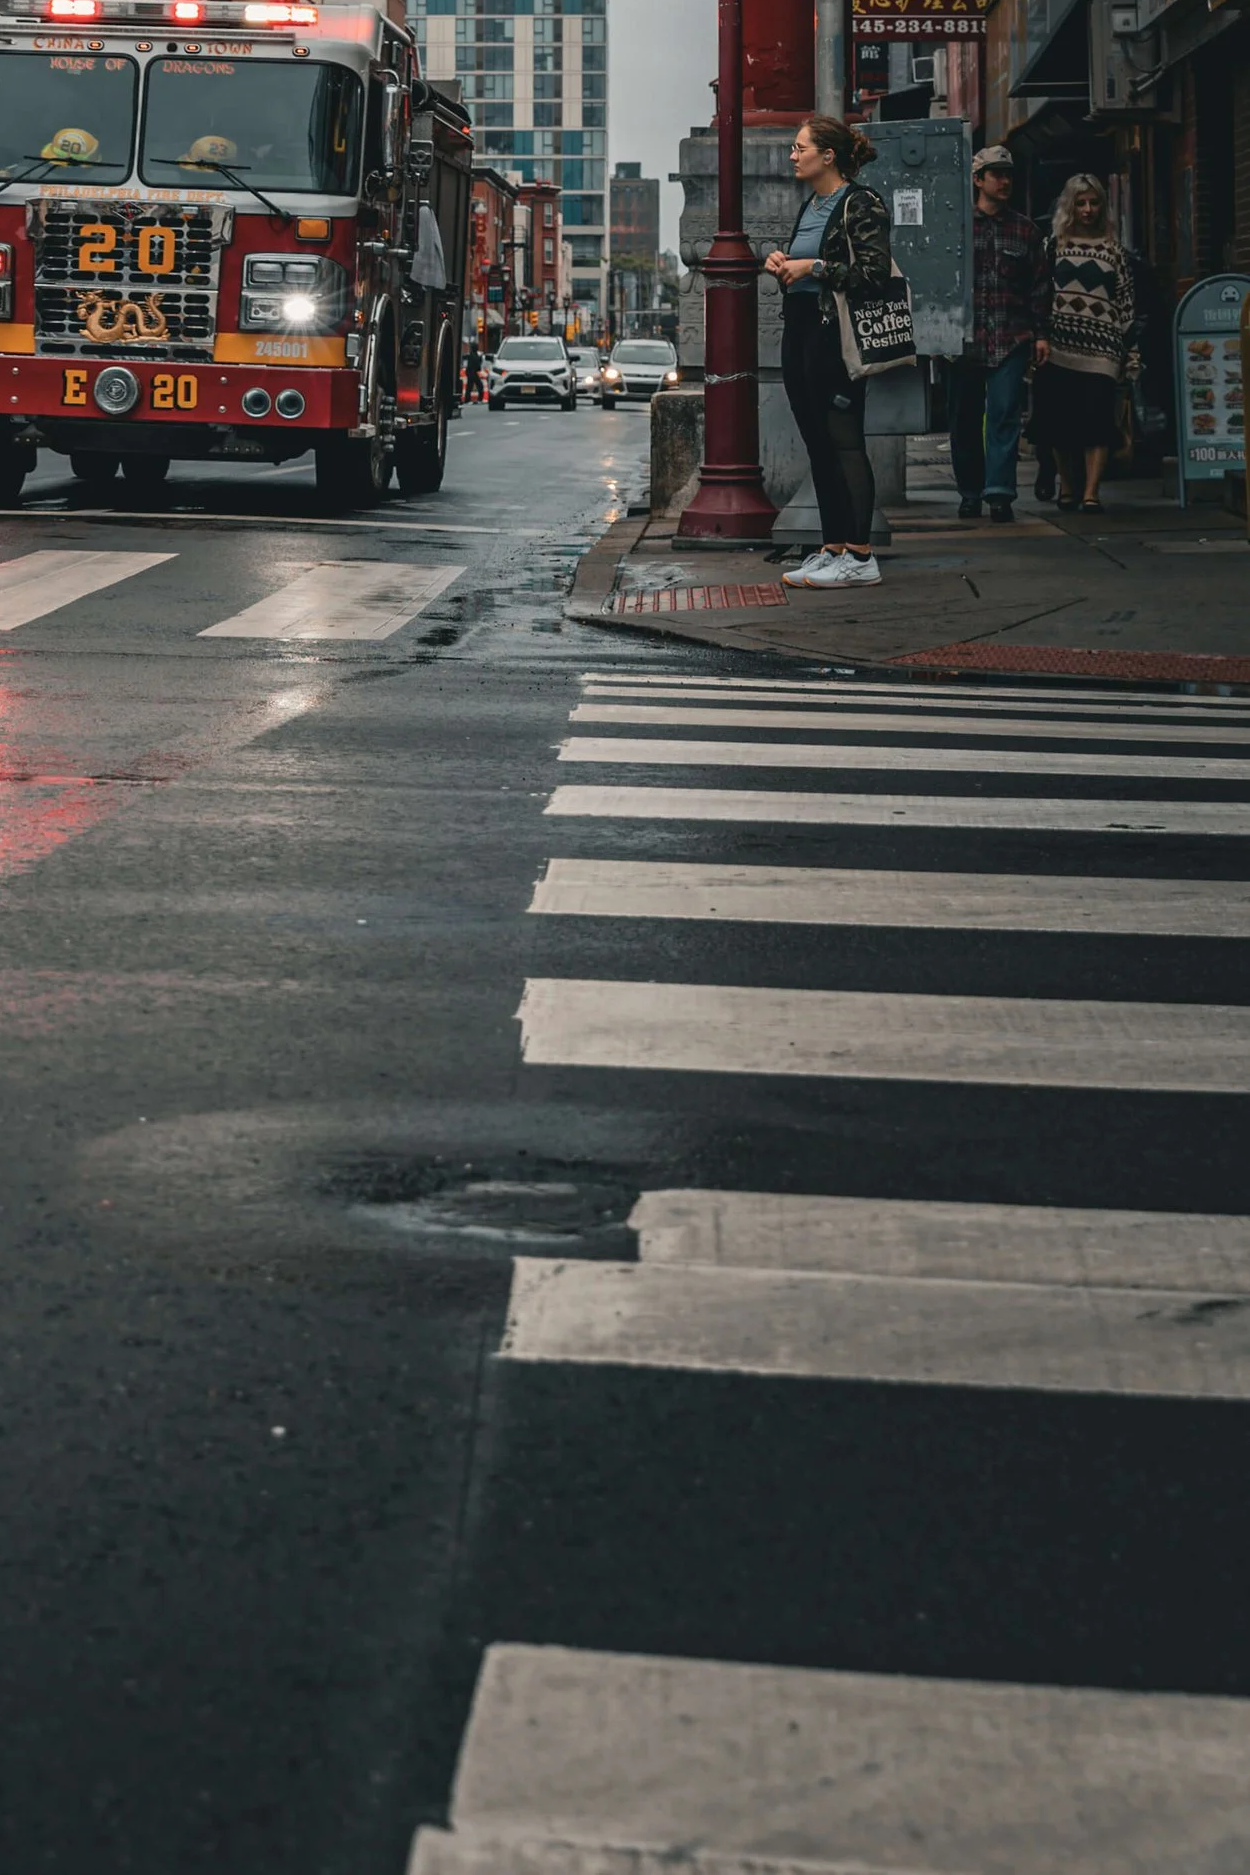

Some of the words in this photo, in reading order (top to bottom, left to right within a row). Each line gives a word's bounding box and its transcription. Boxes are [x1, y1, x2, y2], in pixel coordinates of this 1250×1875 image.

[33, 36, 84, 50] CHINA
[206, 42, 253, 55] TOWN
[50, 57, 95, 71] HOUSE
[105, 59, 127, 72] OF
[163, 61, 235, 75] DRAGONS
[62, 139, 81, 154] 20
[39, 185, 140, 201] PHILADELPHIA
[147, 188, 181, 201] FIRE
[78, 223, 176, 274] 20
[854, 306, 884, 322] New
[886, 300, 909, 313] York
[857, 313, 911, 337] Coffee
[255, 341, 309, 358] 245001
[63, 369, 88, 406] E
[152, 373, 198, 409] 20
